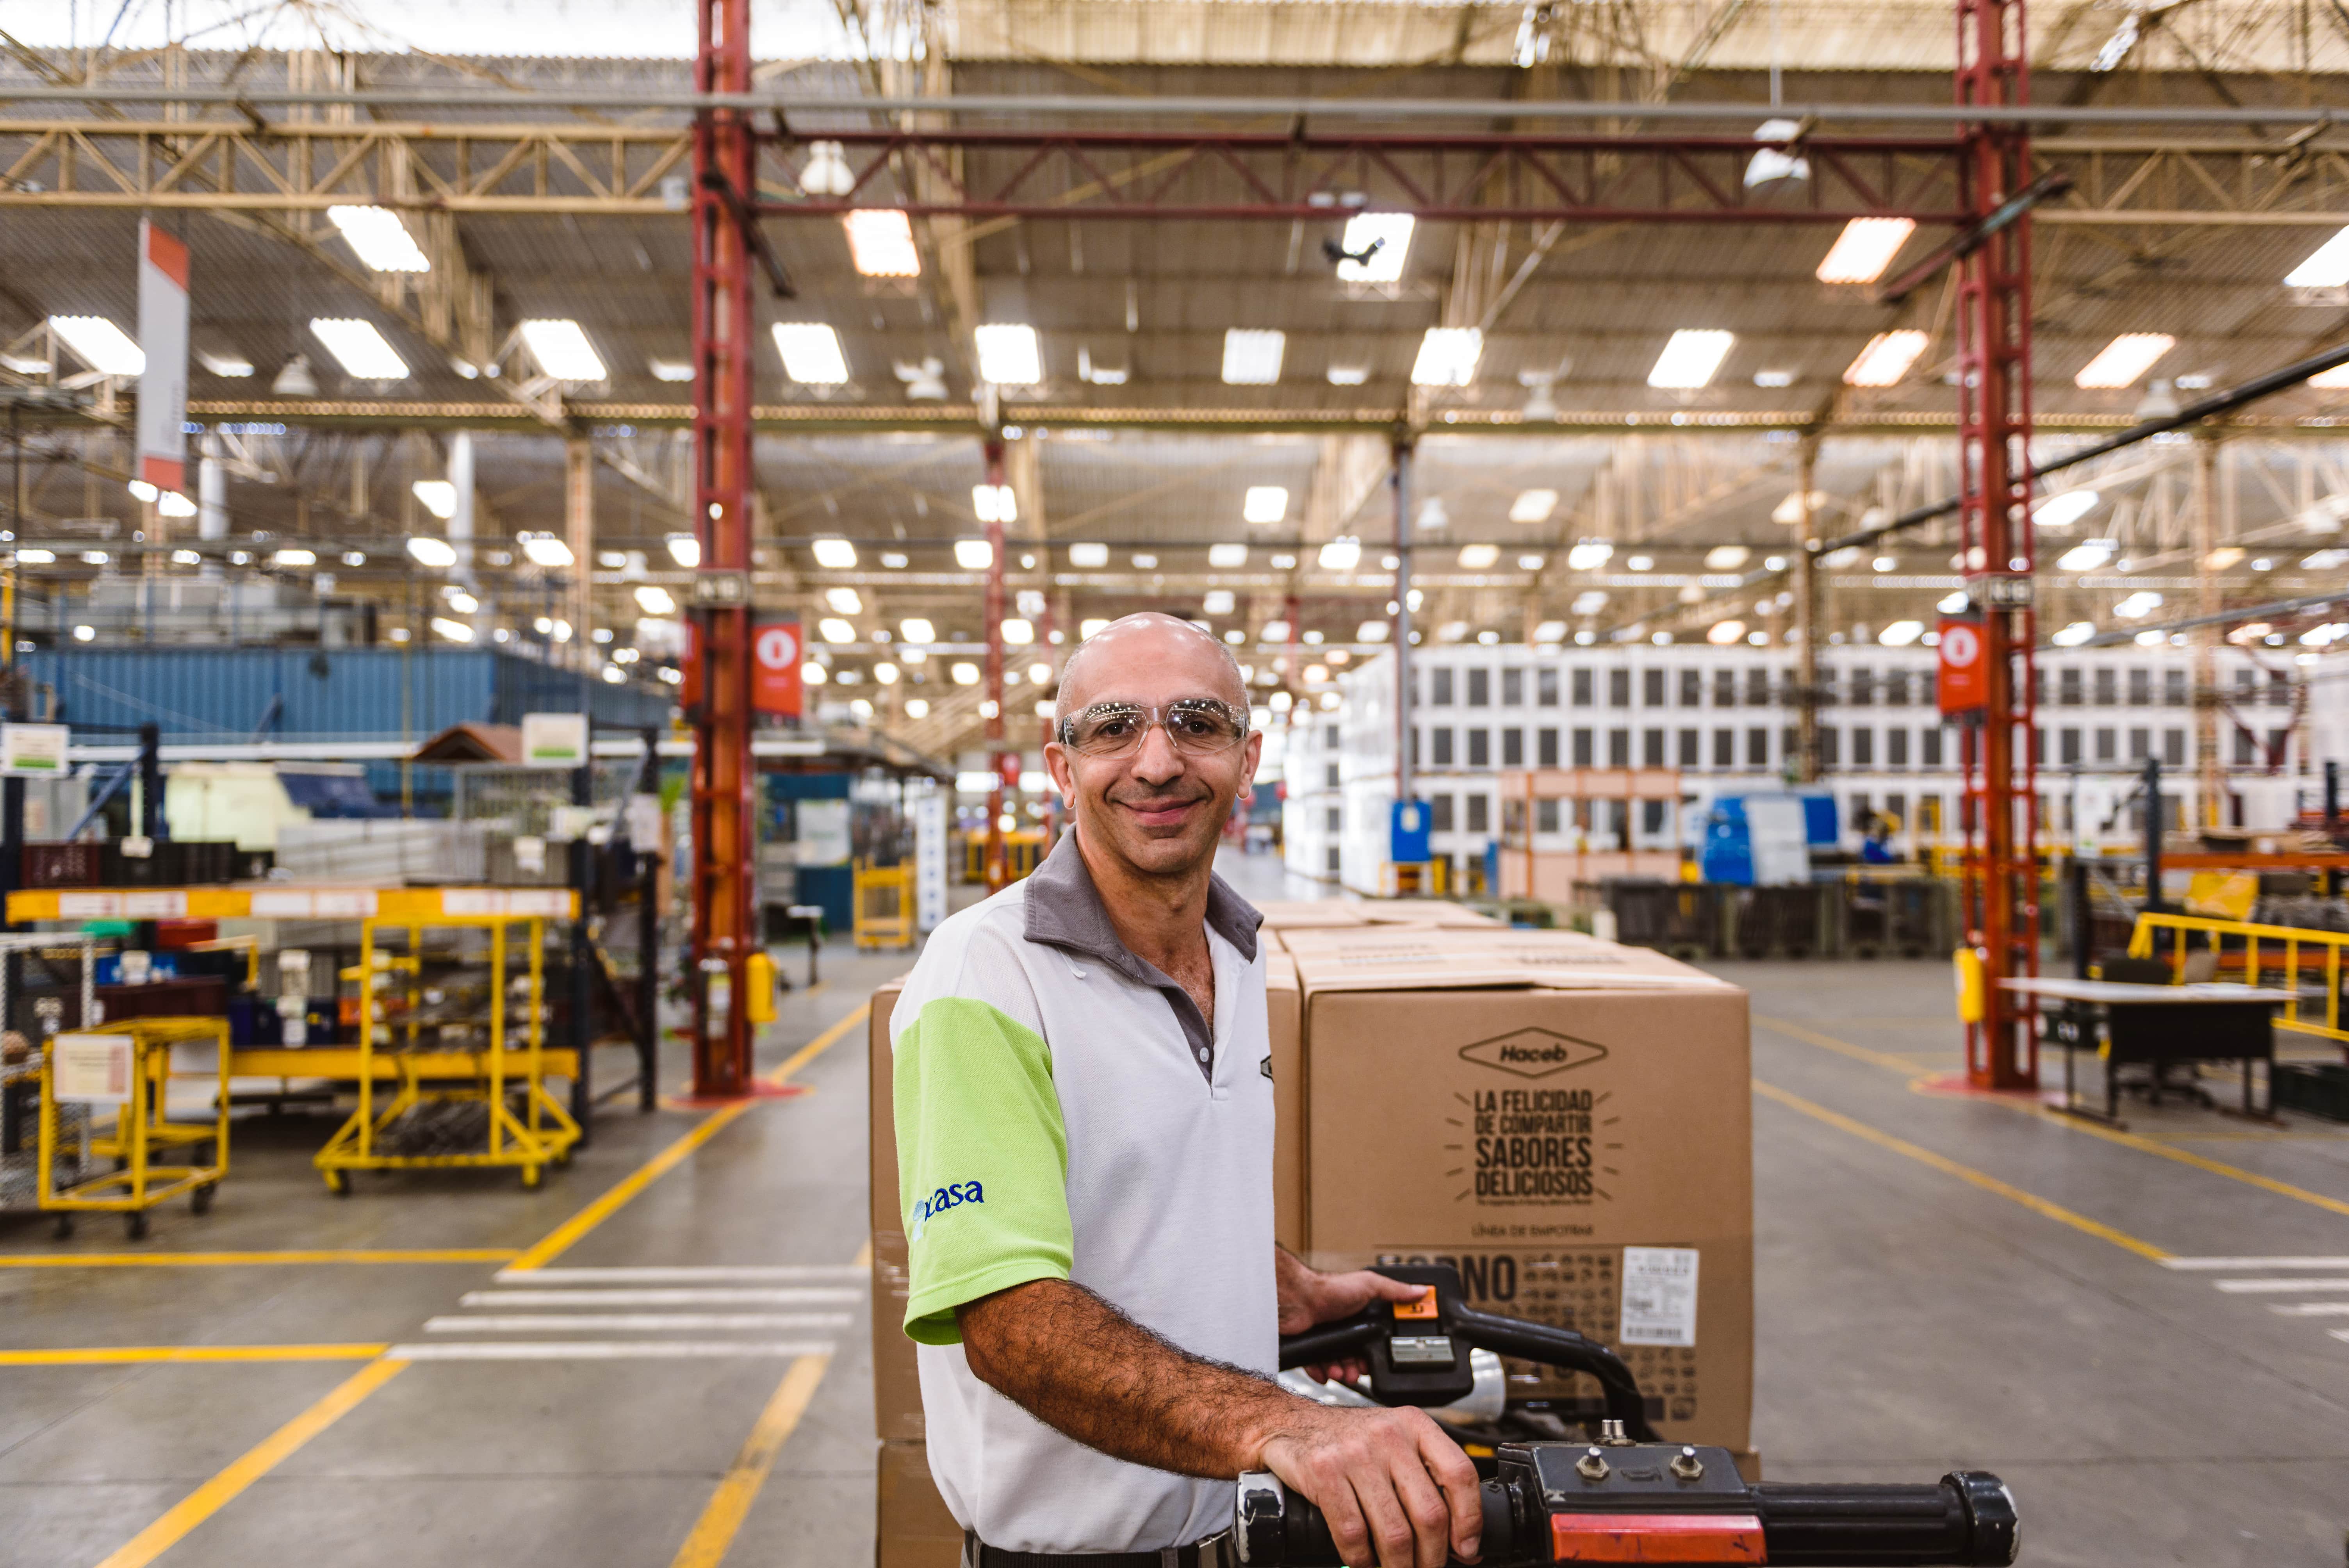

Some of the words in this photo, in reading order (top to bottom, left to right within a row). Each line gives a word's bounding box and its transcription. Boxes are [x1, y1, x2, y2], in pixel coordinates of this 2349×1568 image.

[1500, 1043, 1567, 1062] Haceb
[1475, 1090, 1497, 1112] LA
[1502, 1090, 1592, 1112] FELICIDAD
[1475, 1115, 1495, 1134] DE
[1500, 1114, 1592, 1134] COMPARTIR
[1476, 1137, 1592, 1167] SABORES
[1476, 1171, 1593, 1196] DELICIOSOS
